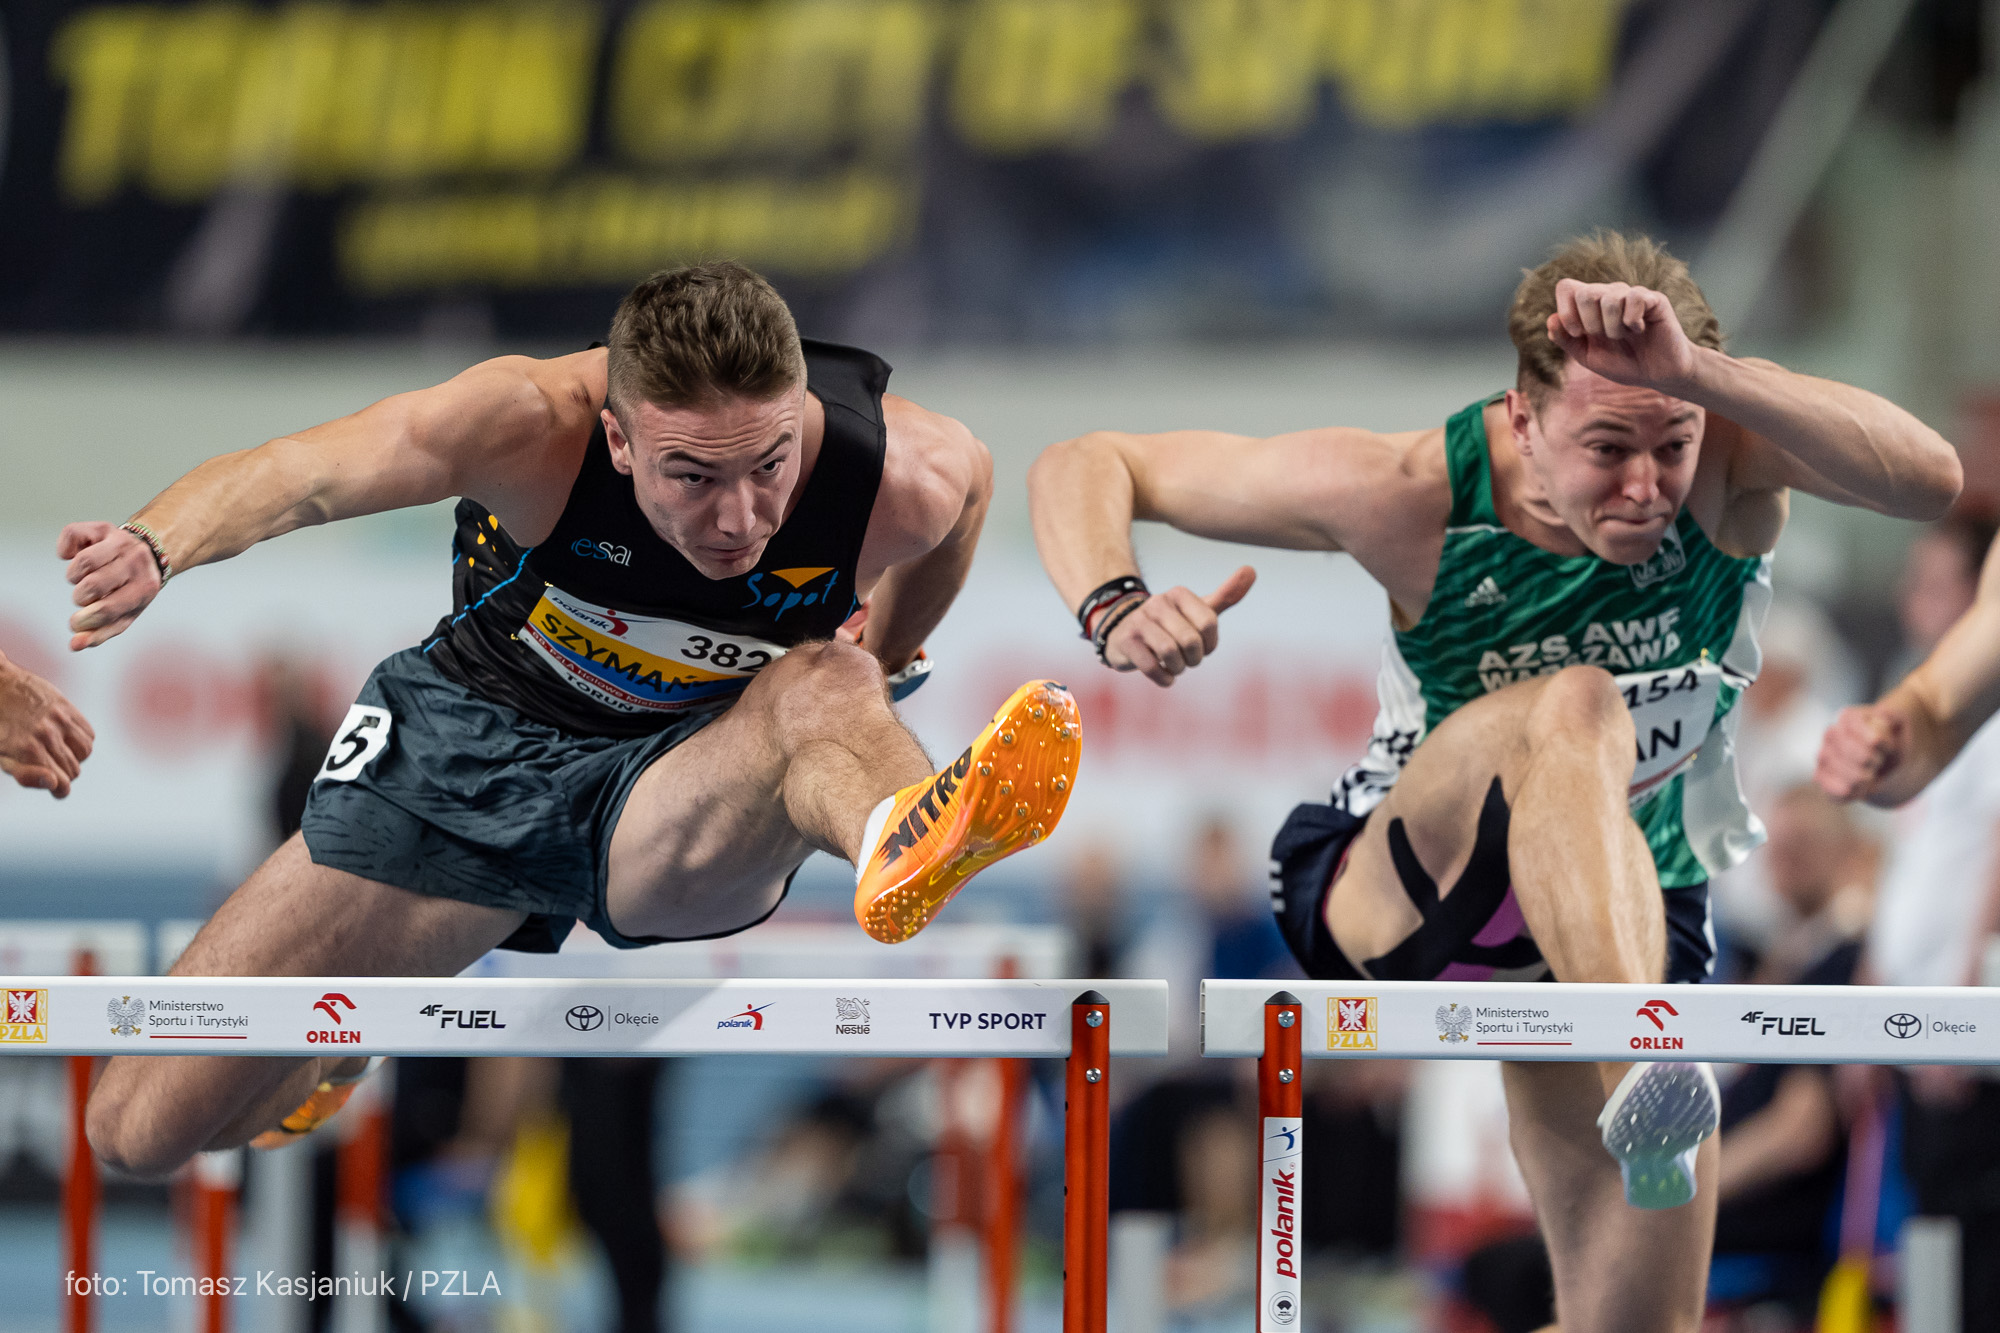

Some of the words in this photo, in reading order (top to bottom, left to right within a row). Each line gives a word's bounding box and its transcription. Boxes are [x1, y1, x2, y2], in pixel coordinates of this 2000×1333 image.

[742, 570, 839, 622] Sopot
[551, 596, 611, 631] polanik
[1478, 635, 1571, 671] AZS
[1582, 607, 1680, 645] AWF
[541, 613, 718, 693] SZYMAŃ
[681, 635, 773, 673] 382
[577, 669, 624, 698] Halowe
[1623, 670, 1701, 709] 154
[326, 715, 381, 771] 5
[876, 746, 973, 872] NITRO
[149, 1000, 224, 1012] Ministerstwo
[1476, 1007, 1549, 1019] Ministerstwo
[149, 1015, 187, 1027] Sportu
[190, 1015, 194, 1026] i
[197, 1015, 248, 1028] Turystyki
[614, 1013, 659, 1027] Okęcie
[717, 1020, 753, 1030] polanik
[929, 1013, 972, 1030] TVP
[978, 1013, 1046, 1030] SPORT
[1476, 1022, 1513, 1034] Sportu
[1516, 1022, 1520, 1032] i
[1523, 1022, 1573, 1035] Turystyki
[1932, 1021, 1976, 1035] Okęcie
[306, 1031, 361, 1044] ORLEN
[1330, 1032, 1375, 1048] PZLA
[1630, 1037, 1683, 1050] ORLEN
[1270, 1168, 1297, 1279] polanik
